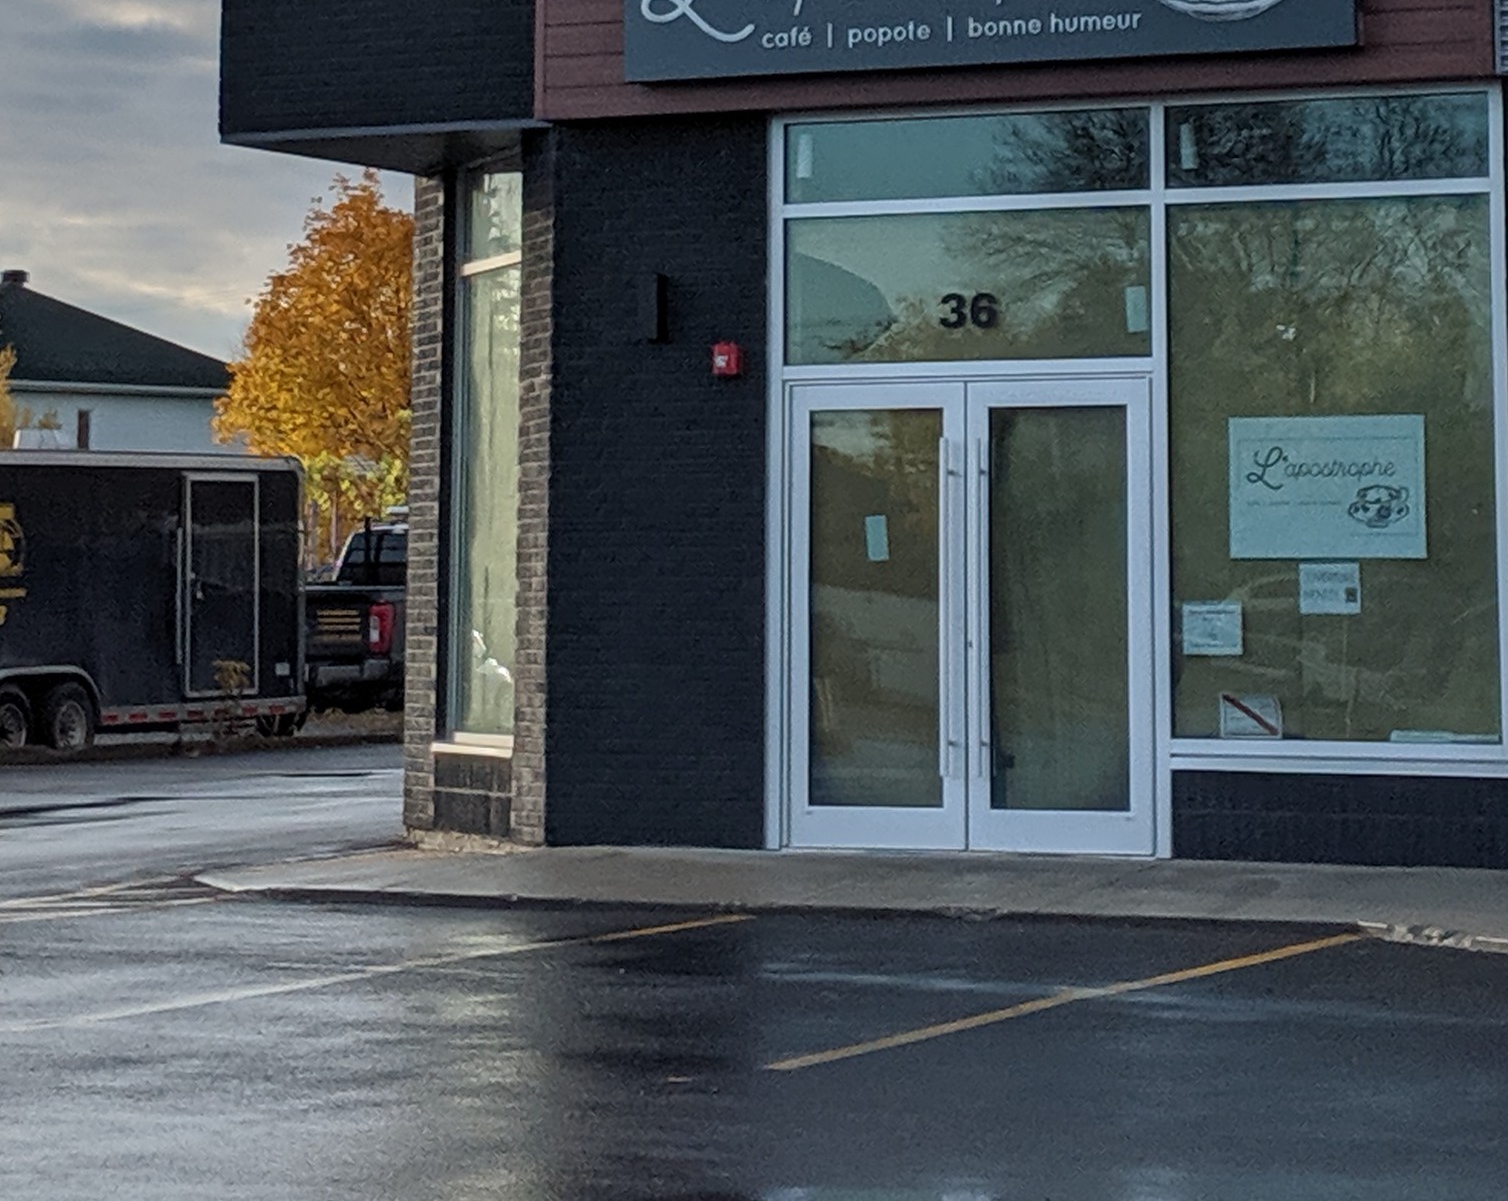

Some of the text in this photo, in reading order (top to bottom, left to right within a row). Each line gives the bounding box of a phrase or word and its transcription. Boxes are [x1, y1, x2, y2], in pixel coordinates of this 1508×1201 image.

[761, 25, 812, 49] café
[847, 20, 931, 48] popote
[967, 17, 1042, 38] bonne
[1050, 11, 1142, 34] humeur
[940, 292, 998, 329] 36
